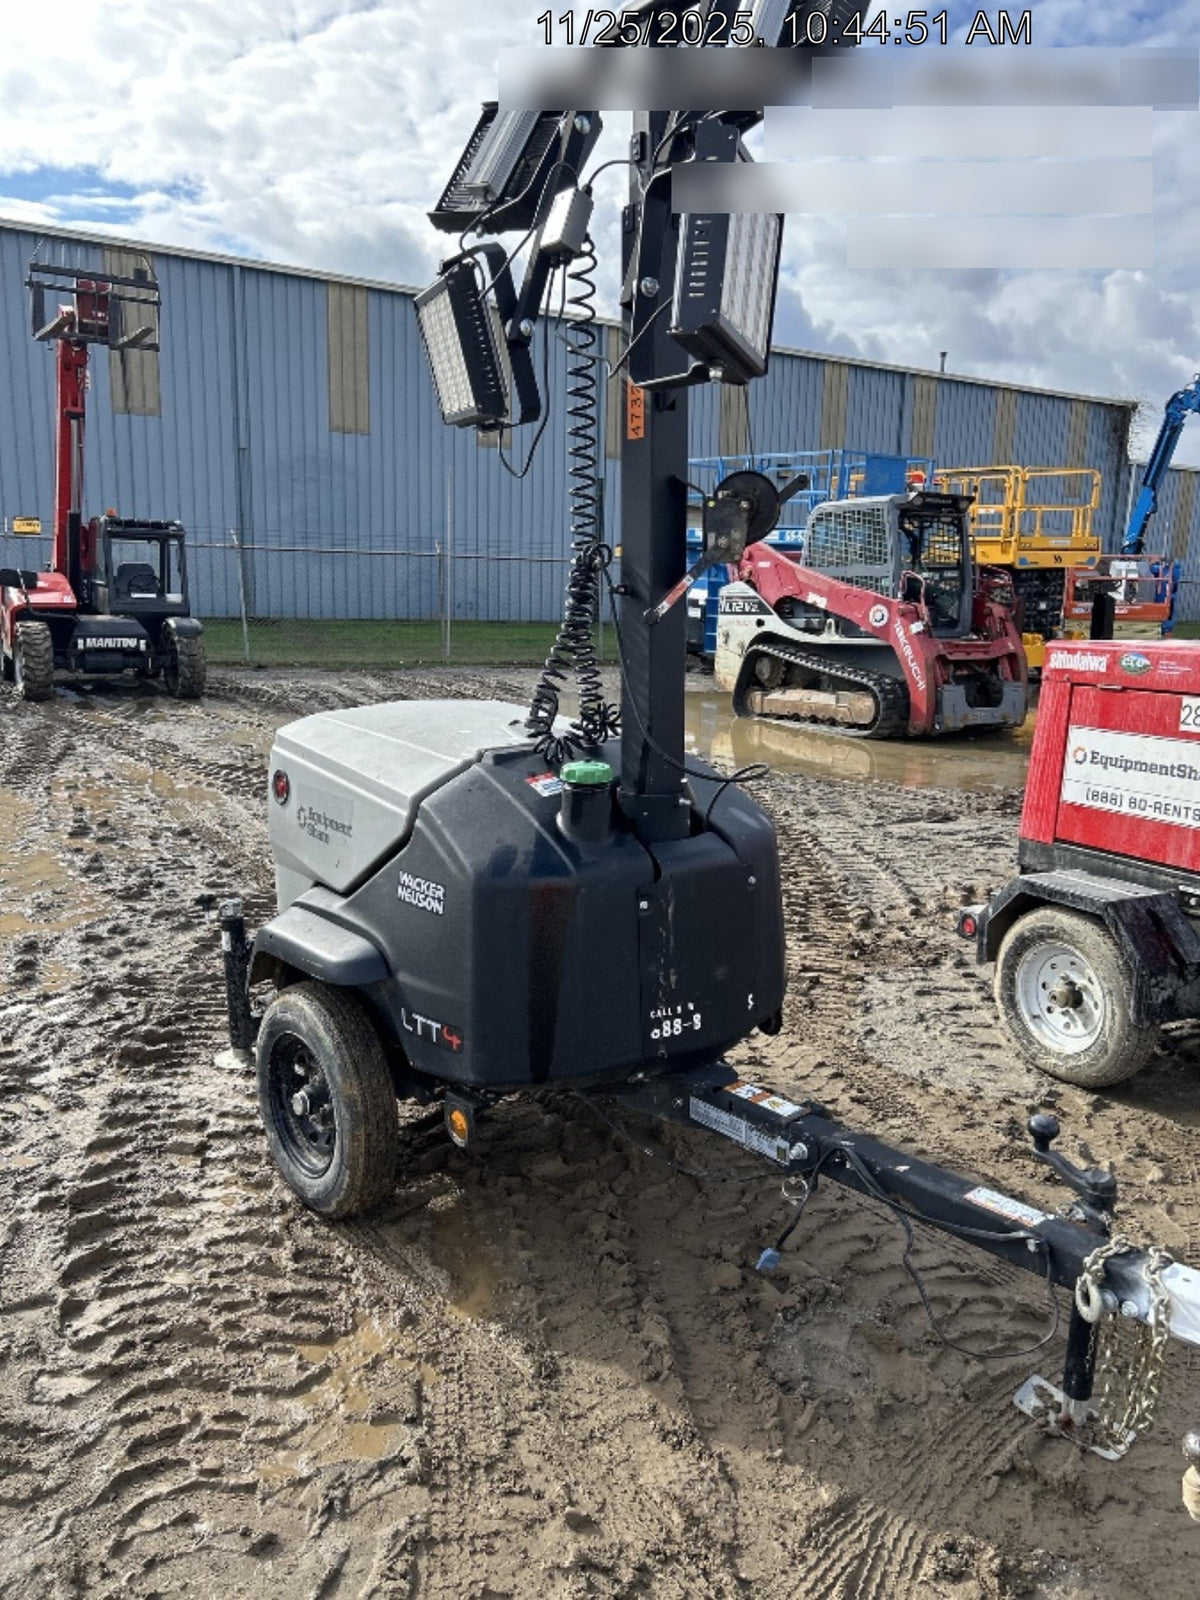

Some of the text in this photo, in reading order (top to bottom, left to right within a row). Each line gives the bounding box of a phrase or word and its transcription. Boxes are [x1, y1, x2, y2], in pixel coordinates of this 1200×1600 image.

[86, 637, 138, 648] MANITOU
[1049, 650, 1107, 673] shindaiwa
[1089, 750, 1200, 781] EquipmentSh
[1086, 787, 1200, 822] (888) 80-RENTS
[398, 885, 443, 914] NEUSON
[399, 870, 445, 900] WACKER
